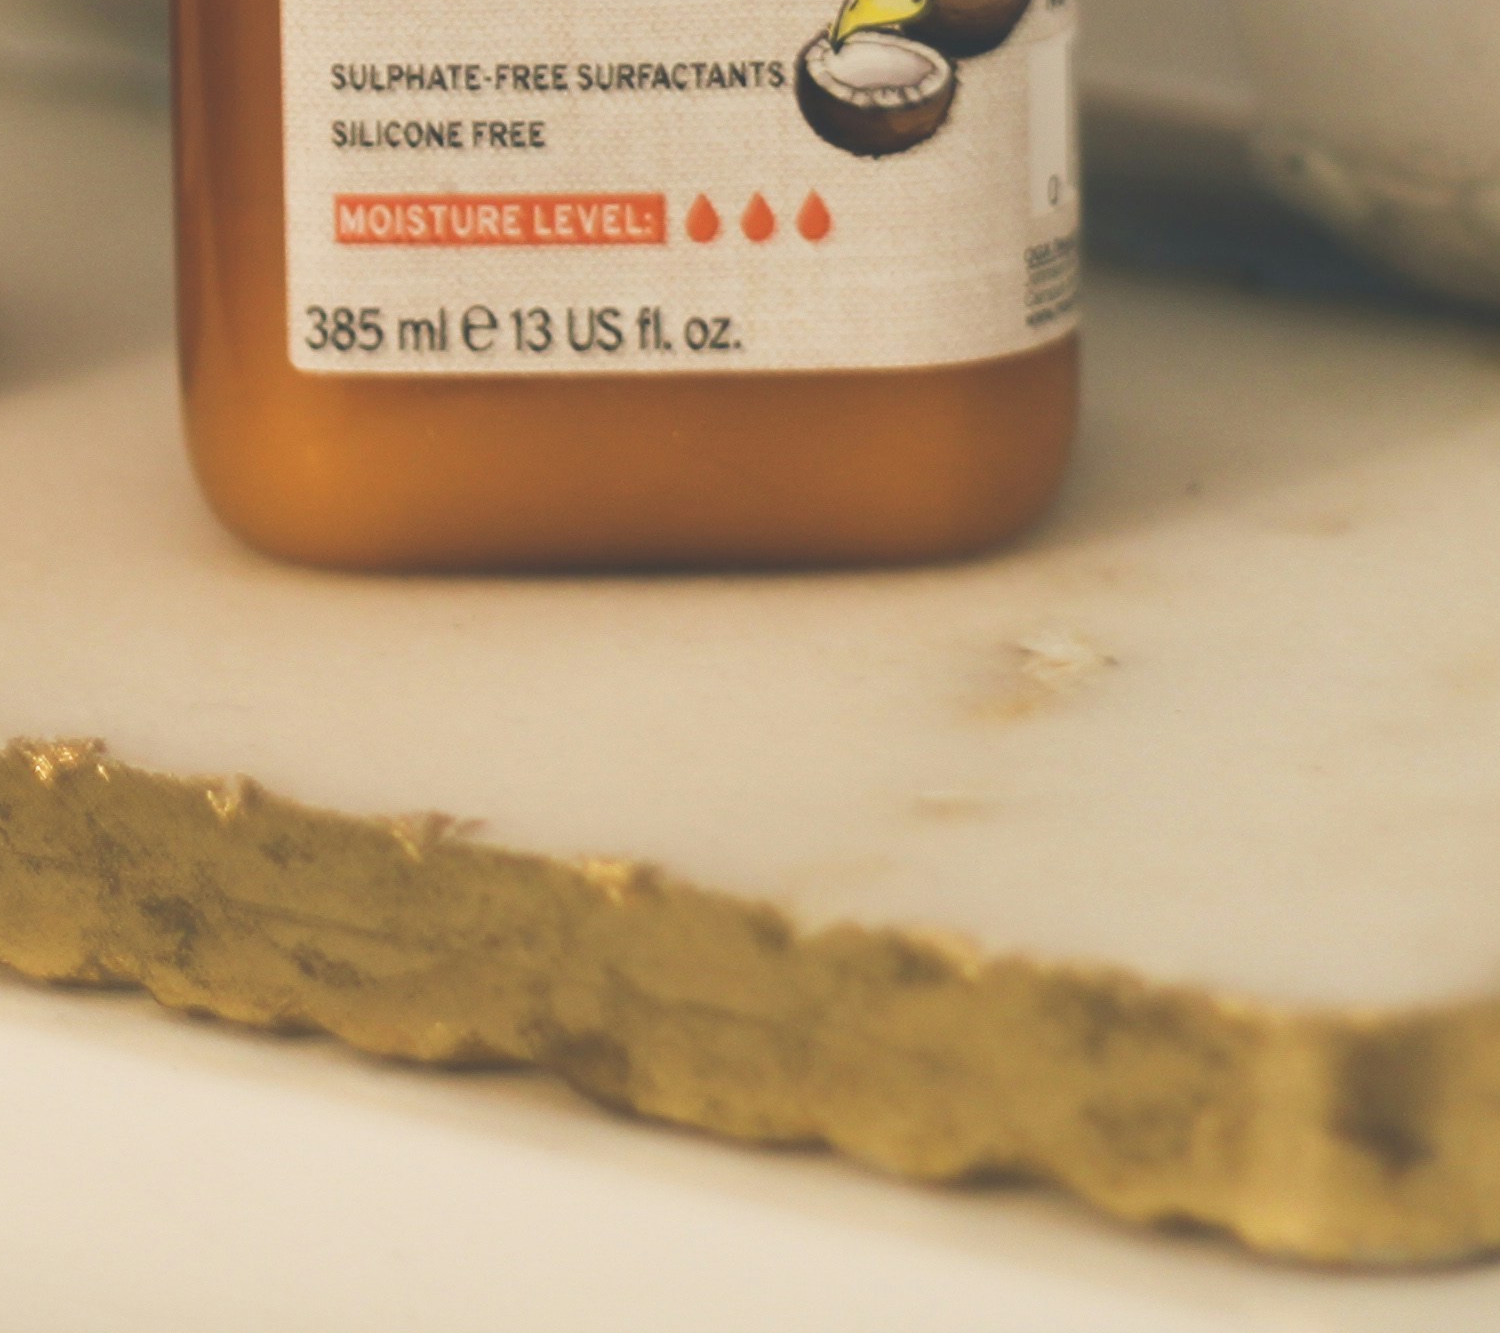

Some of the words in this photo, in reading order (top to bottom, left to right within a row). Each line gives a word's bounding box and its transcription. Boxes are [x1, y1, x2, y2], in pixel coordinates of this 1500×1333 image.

[331, 63, 569, 93] SULPHATE-FREE
[577, 60, 786, 91] SURFACTANTS
[331, 121, 465, 149] SILICONE
[472, 121, 545, 148] FREE
[338, 202, 521, 238] MOISTURE
[531, 202, 653, 236] LEVEL:
[305, 305, 383, 353] 385
[397, 305, 448, 353] ml
[513, 305, 552, 352] 13
[565, 308, 624, 352] US
[638, 305, 673, 352] fl.
[684, 318, 742, 352] oz.
